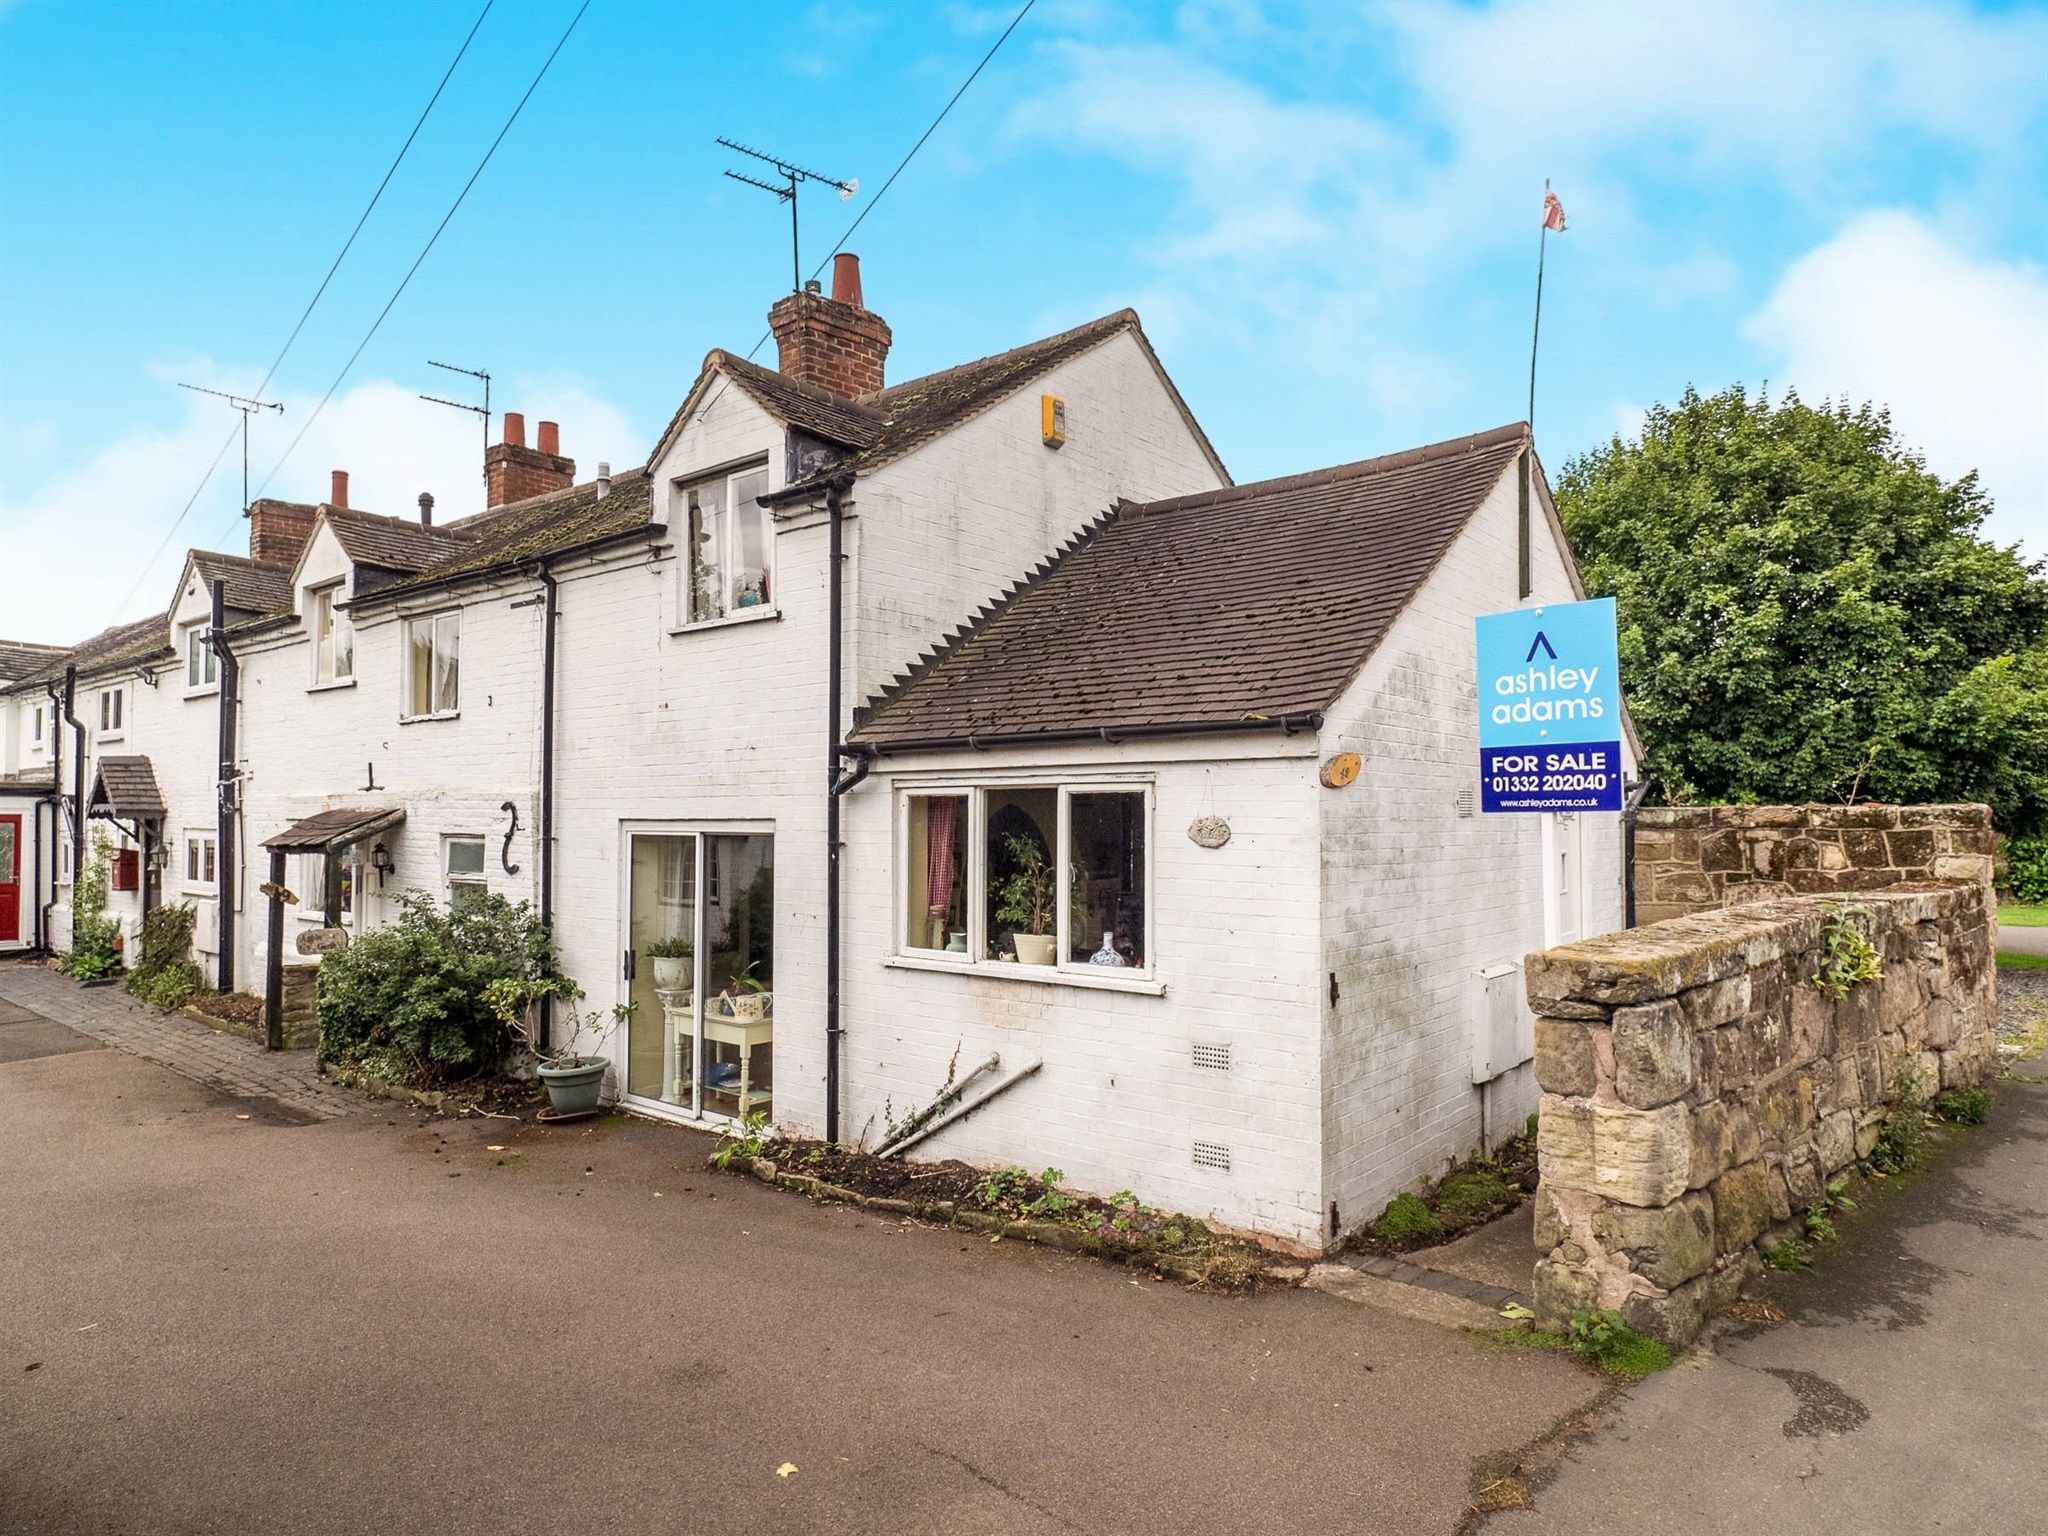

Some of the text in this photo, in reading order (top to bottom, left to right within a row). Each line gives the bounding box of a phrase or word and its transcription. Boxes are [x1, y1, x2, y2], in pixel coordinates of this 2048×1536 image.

[1495, 665, 1598, 695] ashley
[1492, 697, 1603, 724] adams
[1492, 752, 1606, 773] FOR SALE
[1493, 774, 1607, 793] 01332 202040
[1500, 797, 1598, 808] www.ashleyadams.co.uk
